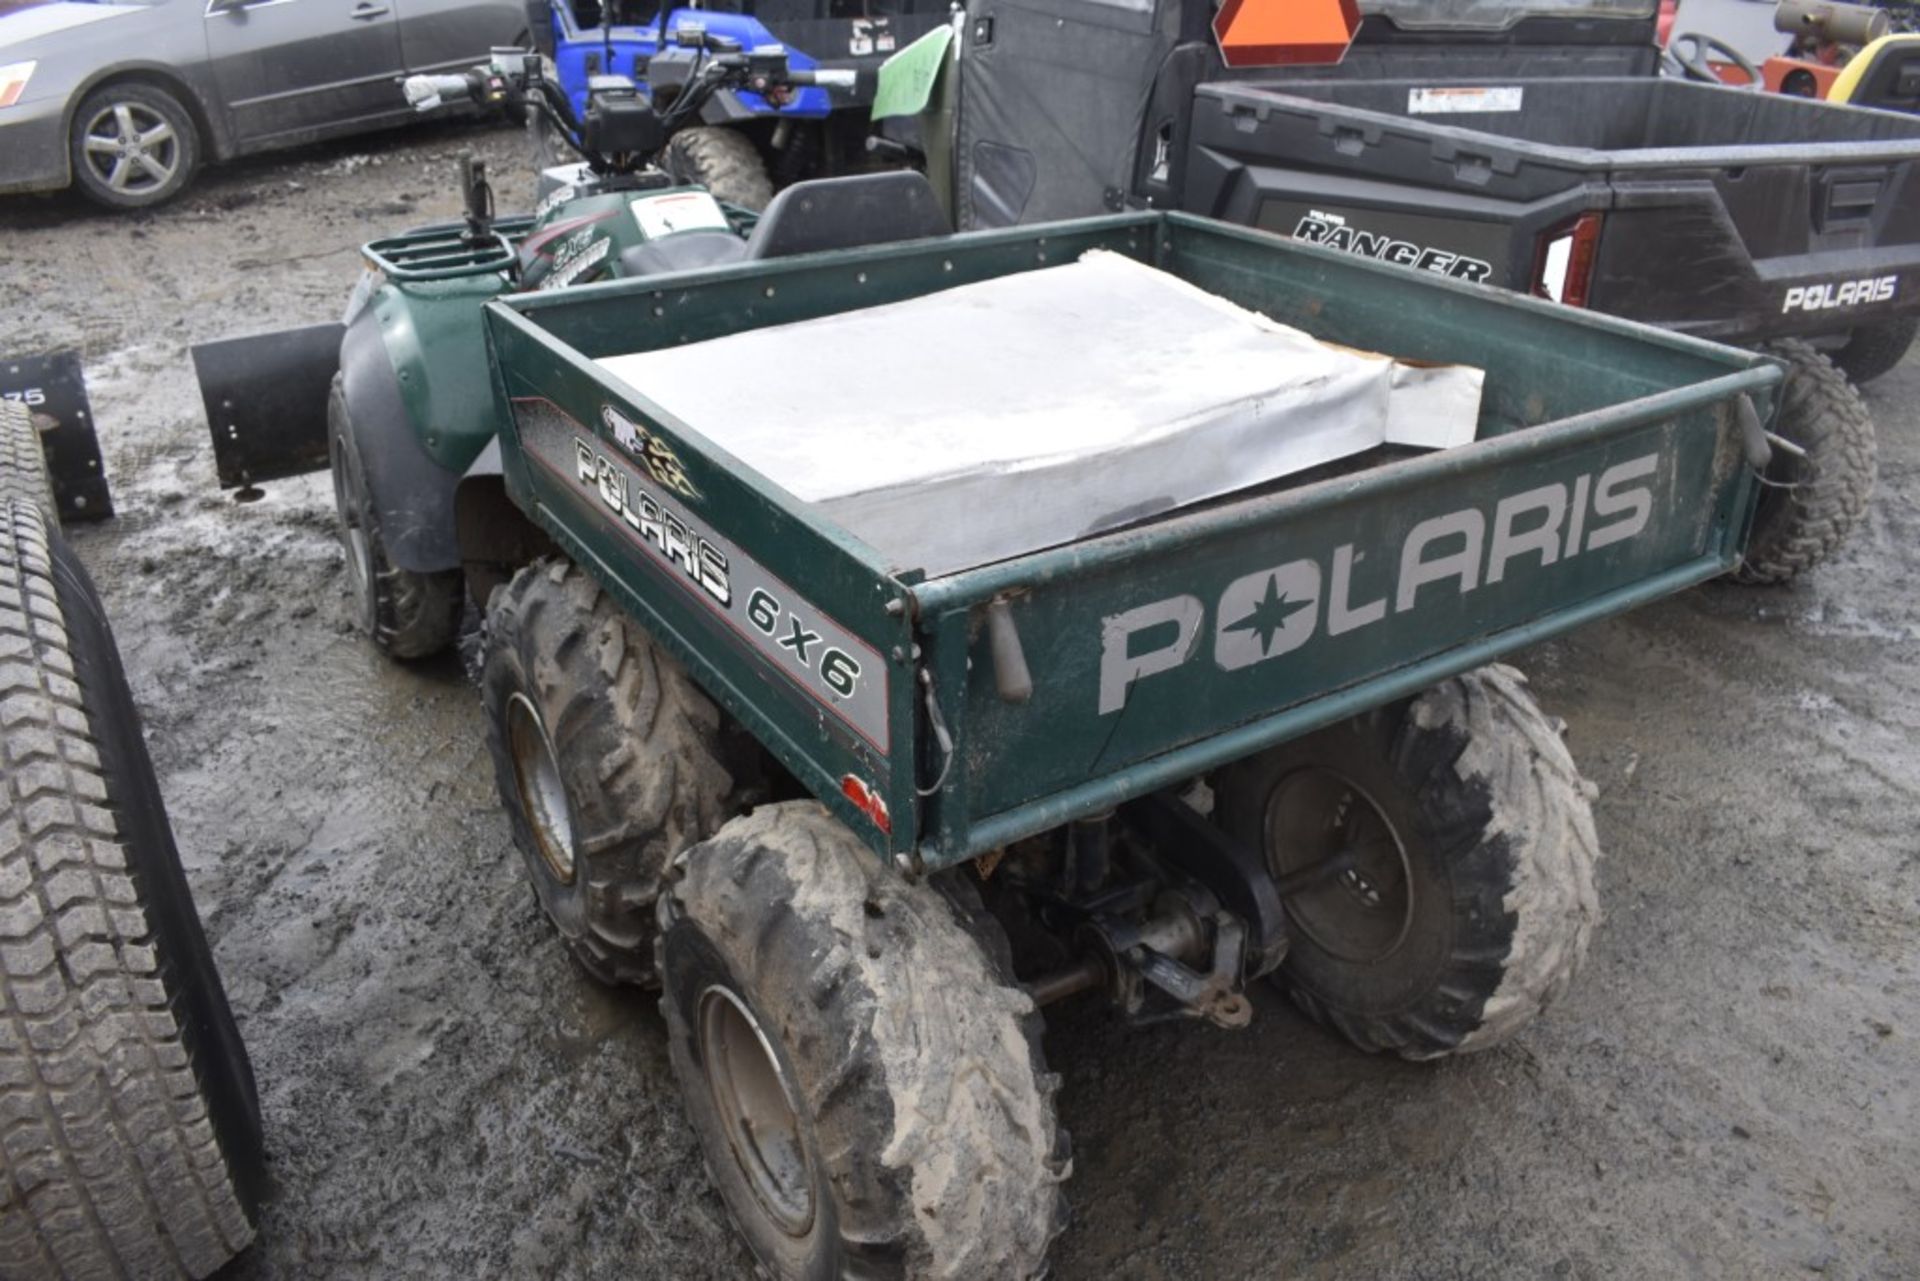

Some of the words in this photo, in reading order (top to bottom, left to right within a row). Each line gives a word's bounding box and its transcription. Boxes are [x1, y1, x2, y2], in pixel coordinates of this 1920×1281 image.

[1293, 216, 1492, 284] RANGER
[1782, 275, 1898, 314] POLARIS
[575, 436, 731, 608] POLARIS
[1098, 453, 1659, 716] POLARIS
